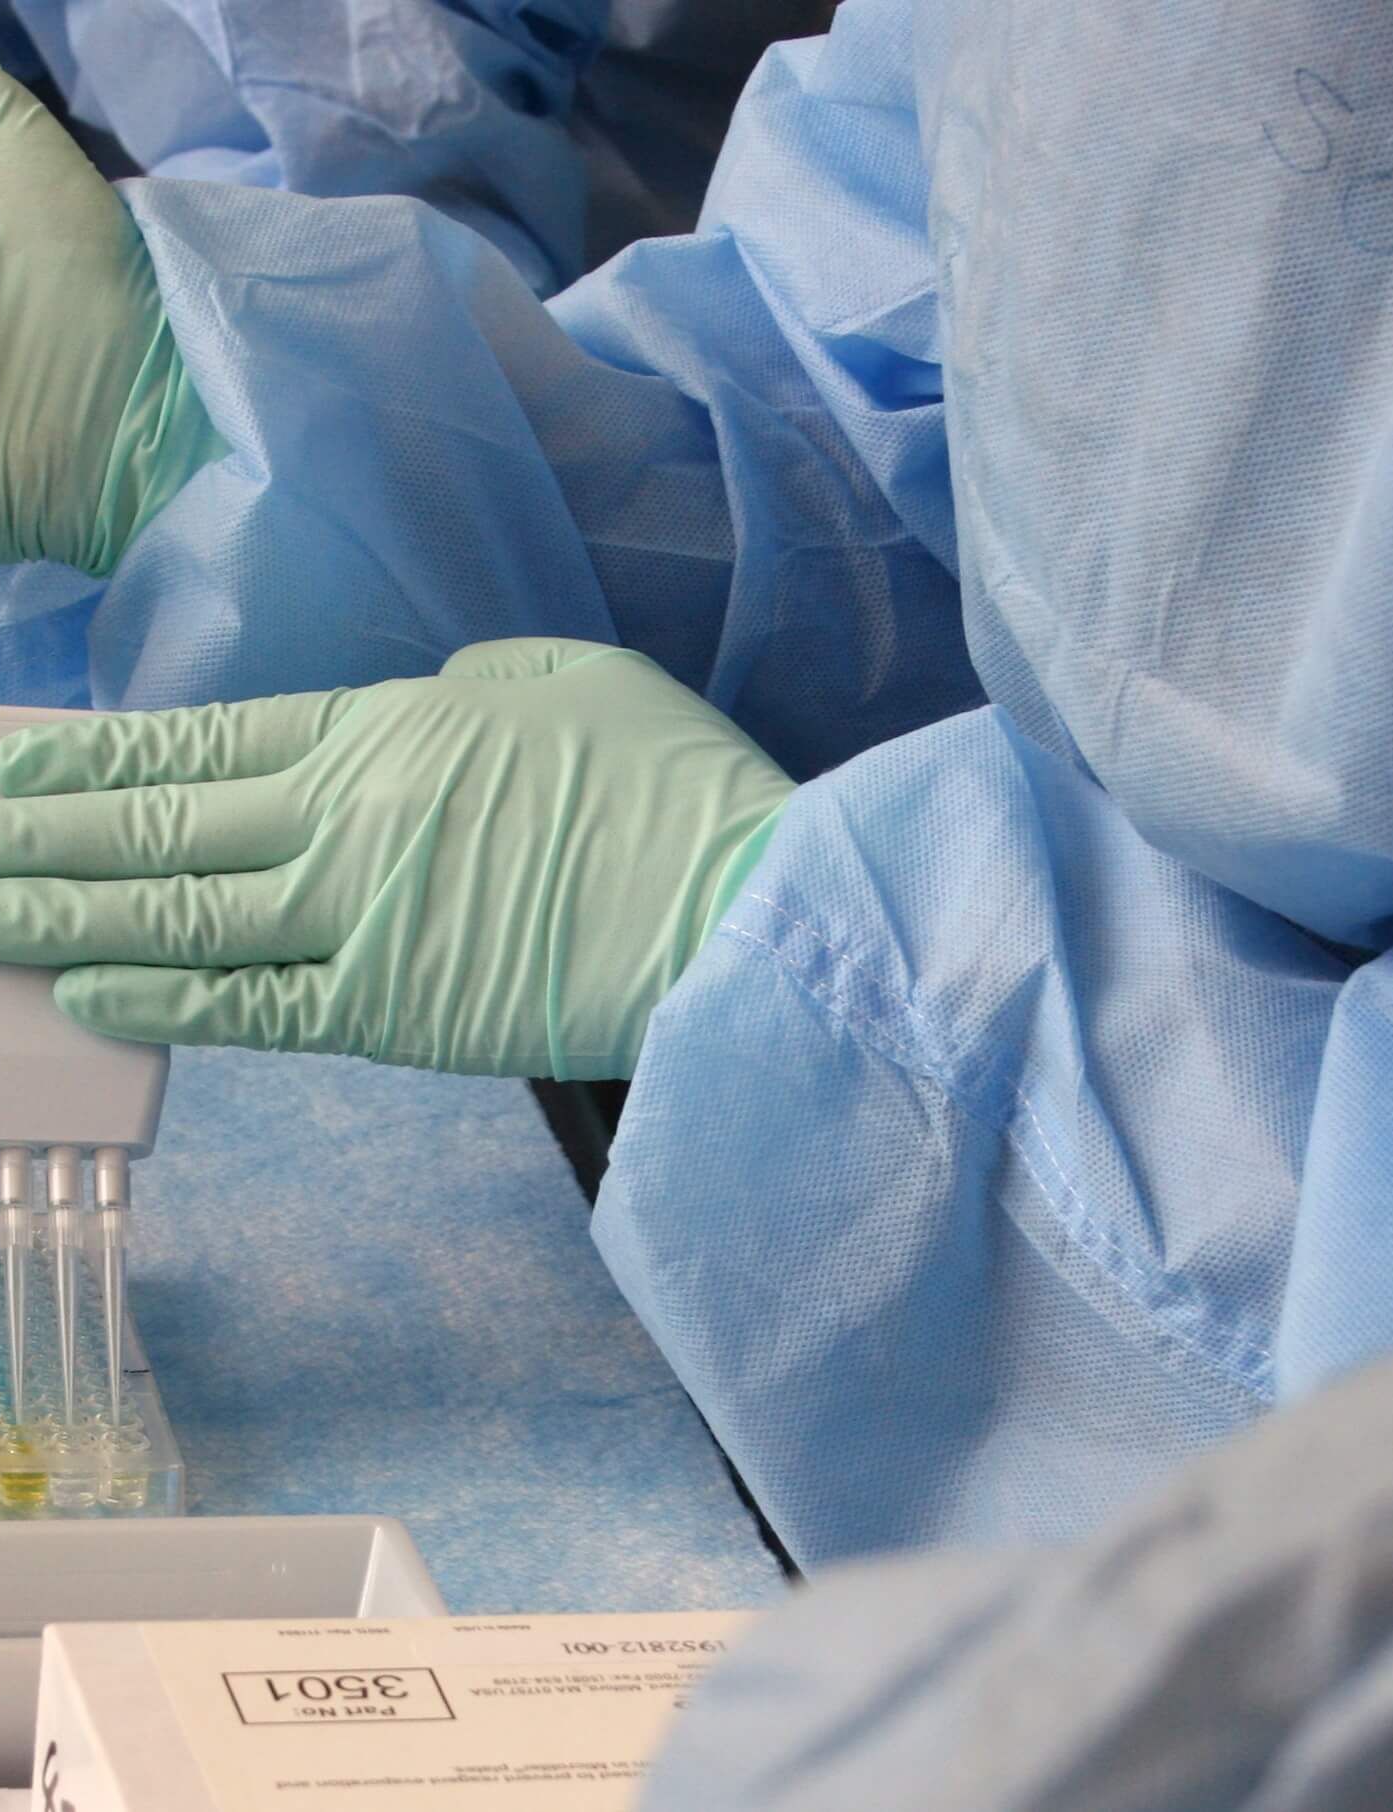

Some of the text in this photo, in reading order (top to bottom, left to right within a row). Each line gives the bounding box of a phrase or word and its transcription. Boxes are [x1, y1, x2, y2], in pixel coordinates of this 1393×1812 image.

[264, 1674, 409, 1703] 3501
[466, 1687, 505, 1697] USA
[554, 1685, 582, 1694] MA
[343, 1705, 398, 1717] Part
